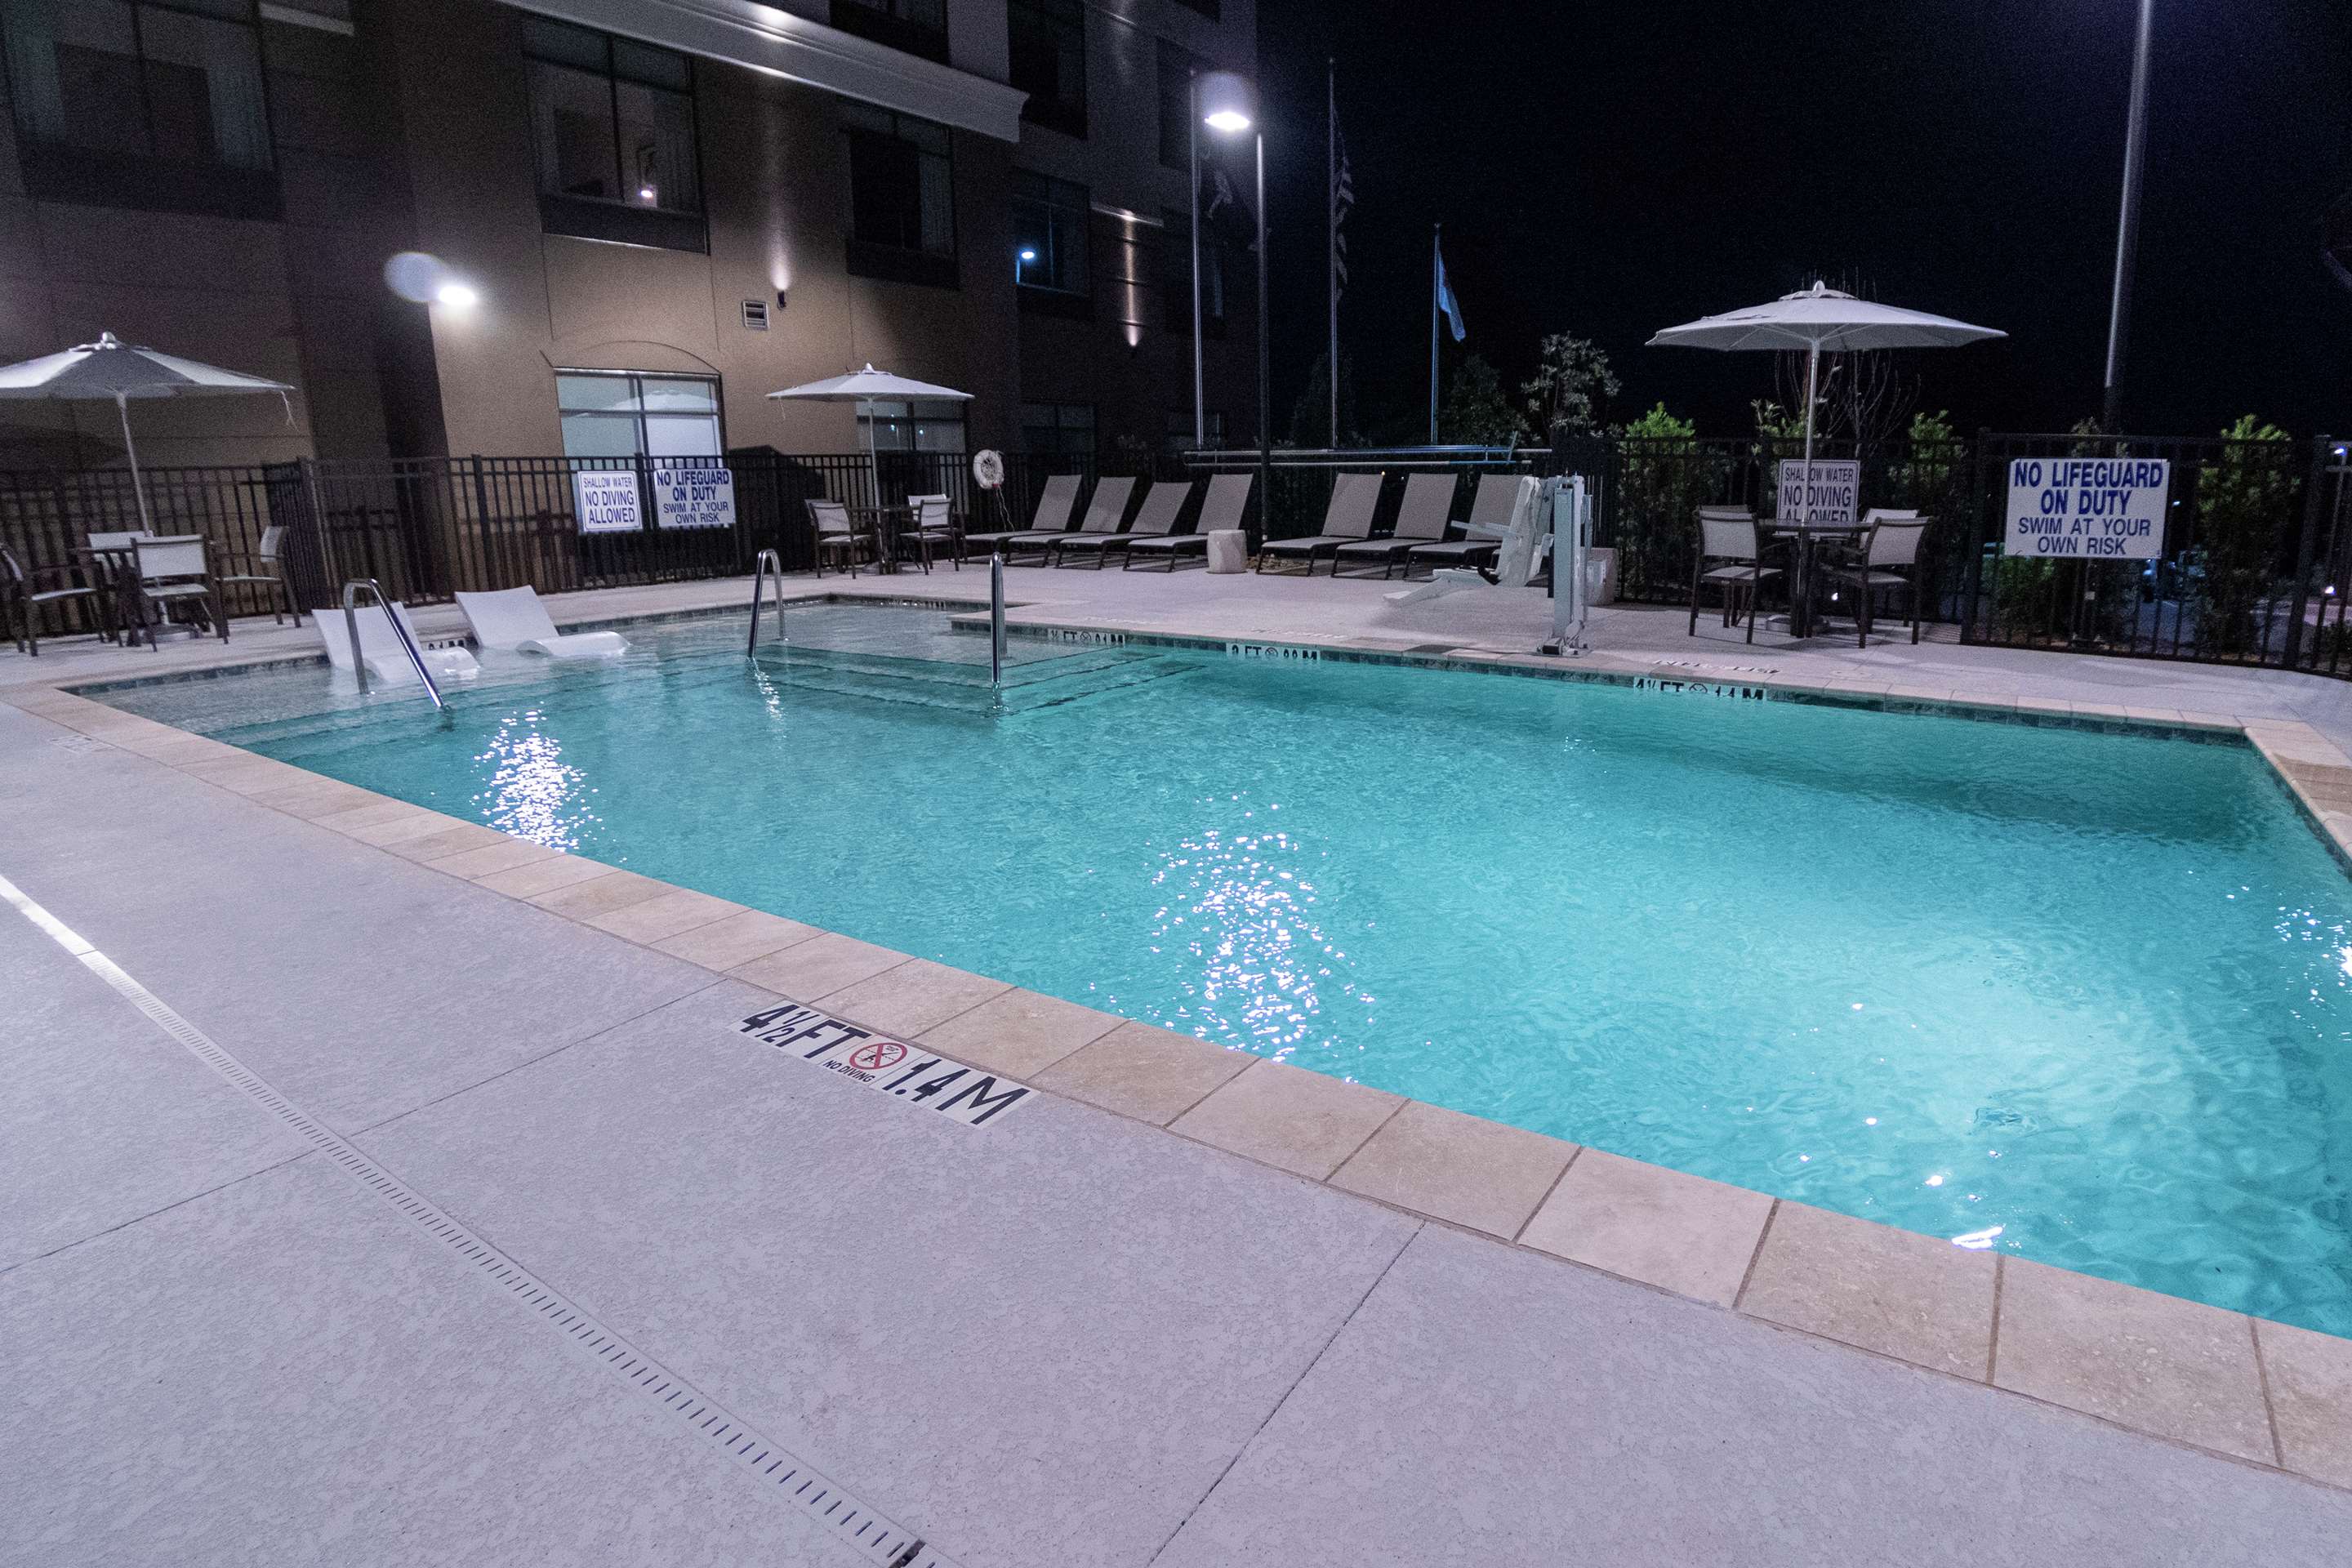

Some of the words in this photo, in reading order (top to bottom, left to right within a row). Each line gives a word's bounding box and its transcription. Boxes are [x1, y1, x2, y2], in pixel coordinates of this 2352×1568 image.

[583, 477, 611, 488] SHALLOW
[612, 476, 633, 488] WATER
[657, 470, 671, 486] NO
[675, 470, 730, 486] LIFEGUARD
[1785, 467, 1824, 482] SHALOW
[1826, 467, 1854, 482] WATER
[2014, 461, 2042, 488] NO
[2051, 461, 2163, 488] LIFEGUARD
[585, 492, 599, 506] NO
[602, 490, 635, 506] DIVING
[673, 487, 687, 501] ON
[694, 486, 717, 501] DUTY
[1784, 485, 1802, 506] NO
[1807, 485, 1852, 507] DIVING
[663, 502, 686, 514] SWIM
[691, 501, 702, 512] AT
[706, 501, 729, 512] YOUR
[2042, 489, 2069, 514] ON
[2078, 490, 2132, 515] DUTY
[589, 507, 635, 523] ALLOWED
[675, 514, 695, 524] OWN
[700, 513, 720, 523] RISK
[1786, 508, 1849, 522] ALOWED
[2019, 517, 2063, 535] SWIM
[2070, 518, 2095, 535] AT
[2103, 518, 2151, 536] YOUR
[2038, 536, 2078, 554] OWN
[2087, 537, 2127, 555] RISK
[822, 1060, 842, 1070] NO
[837, 1065, 876, 1083] DIVING
